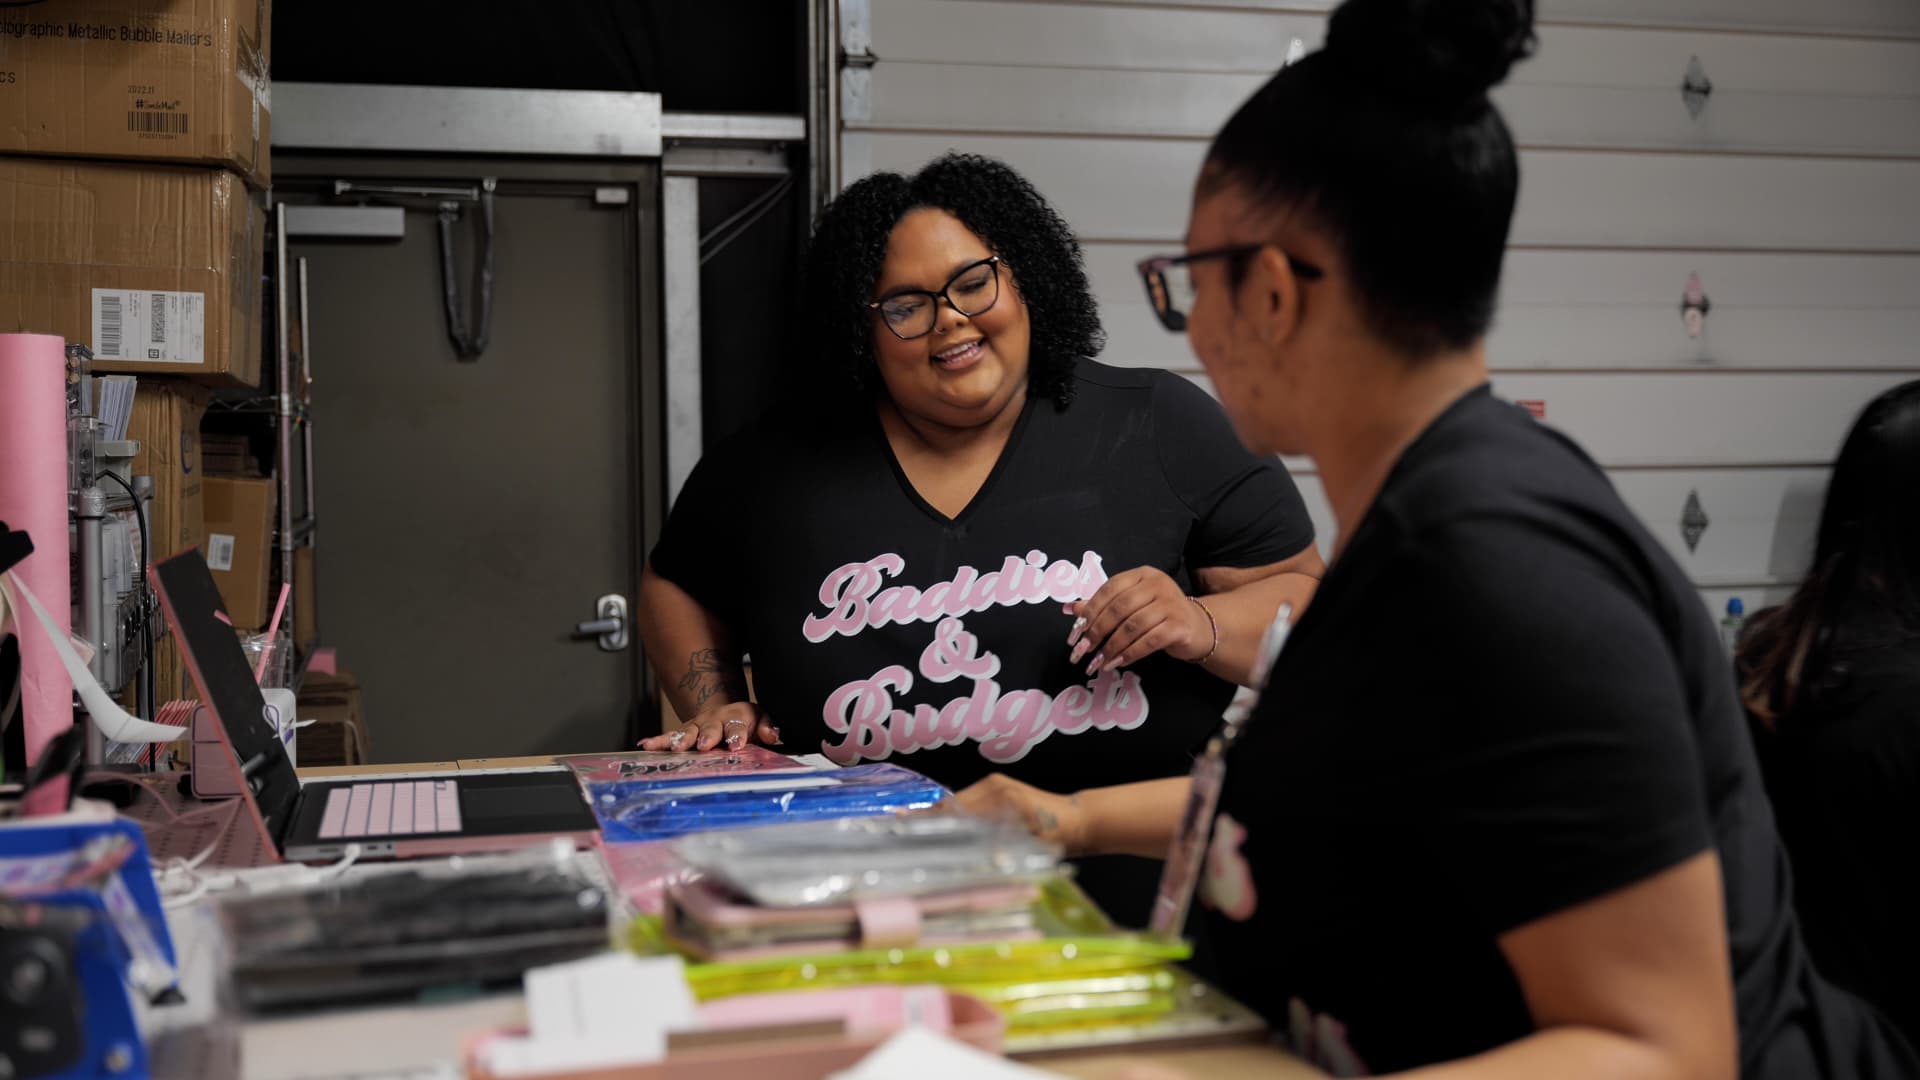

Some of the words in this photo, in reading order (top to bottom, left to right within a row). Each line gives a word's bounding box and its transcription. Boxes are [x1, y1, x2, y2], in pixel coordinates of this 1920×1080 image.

[68, 23, 116, 41] Metallic
[120, 25, 163, 43] Bubble
[166, 29, 212, 47] Mailers
[803, 549, 1108, 643] Baddies
[919, 617, 1001, 682] &
[821, 664, 1149, 766] Budgets
